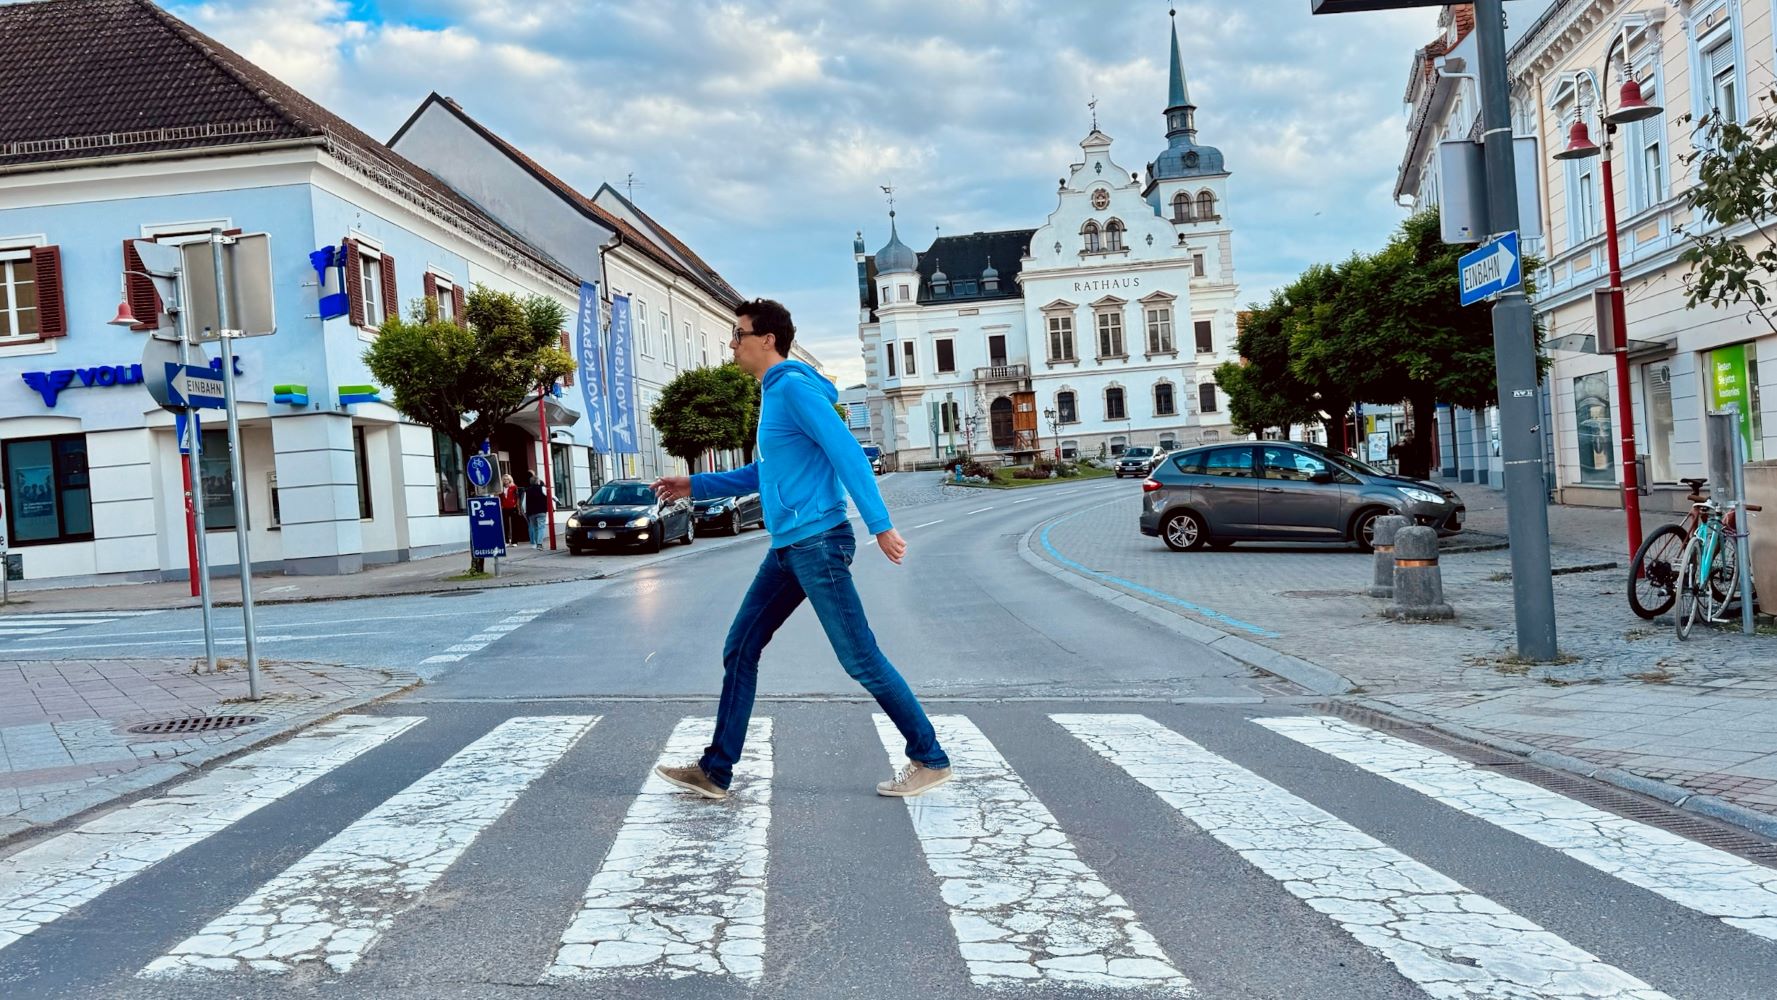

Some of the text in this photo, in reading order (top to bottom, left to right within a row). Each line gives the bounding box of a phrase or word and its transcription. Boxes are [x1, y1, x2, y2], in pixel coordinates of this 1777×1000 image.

[1464, 255, 1500, 290] EINBAHN
[1074, 277, 1140, 292] RATHAUS
[186, 379, 222, 395] EINBAHN
